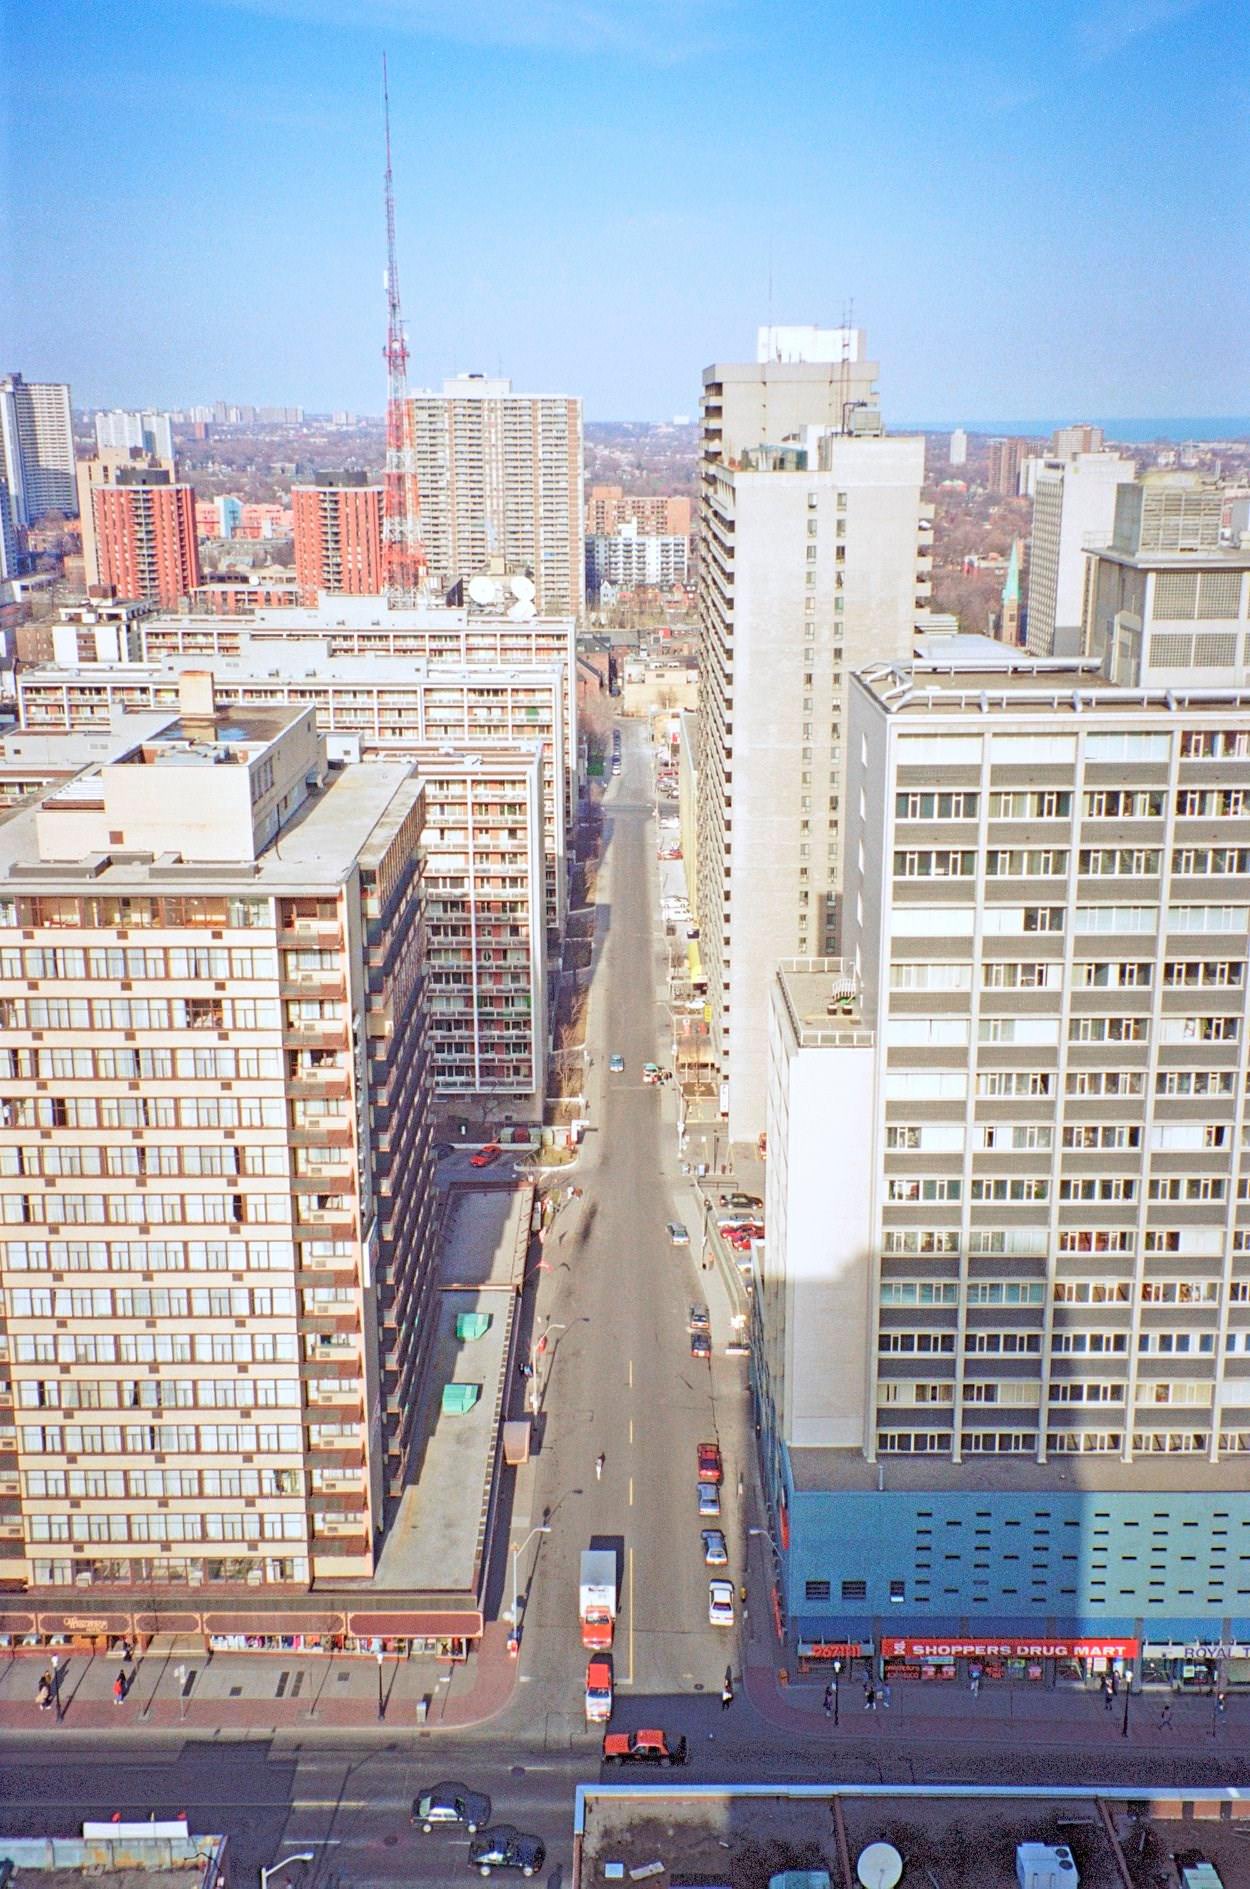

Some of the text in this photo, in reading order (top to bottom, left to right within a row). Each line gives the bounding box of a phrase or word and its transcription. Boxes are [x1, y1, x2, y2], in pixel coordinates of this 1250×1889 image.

[912, 1645, 1126, 1656] SHOPPERS DRUG MART
[1184, 1647, 1233, 1658] ROYAL
